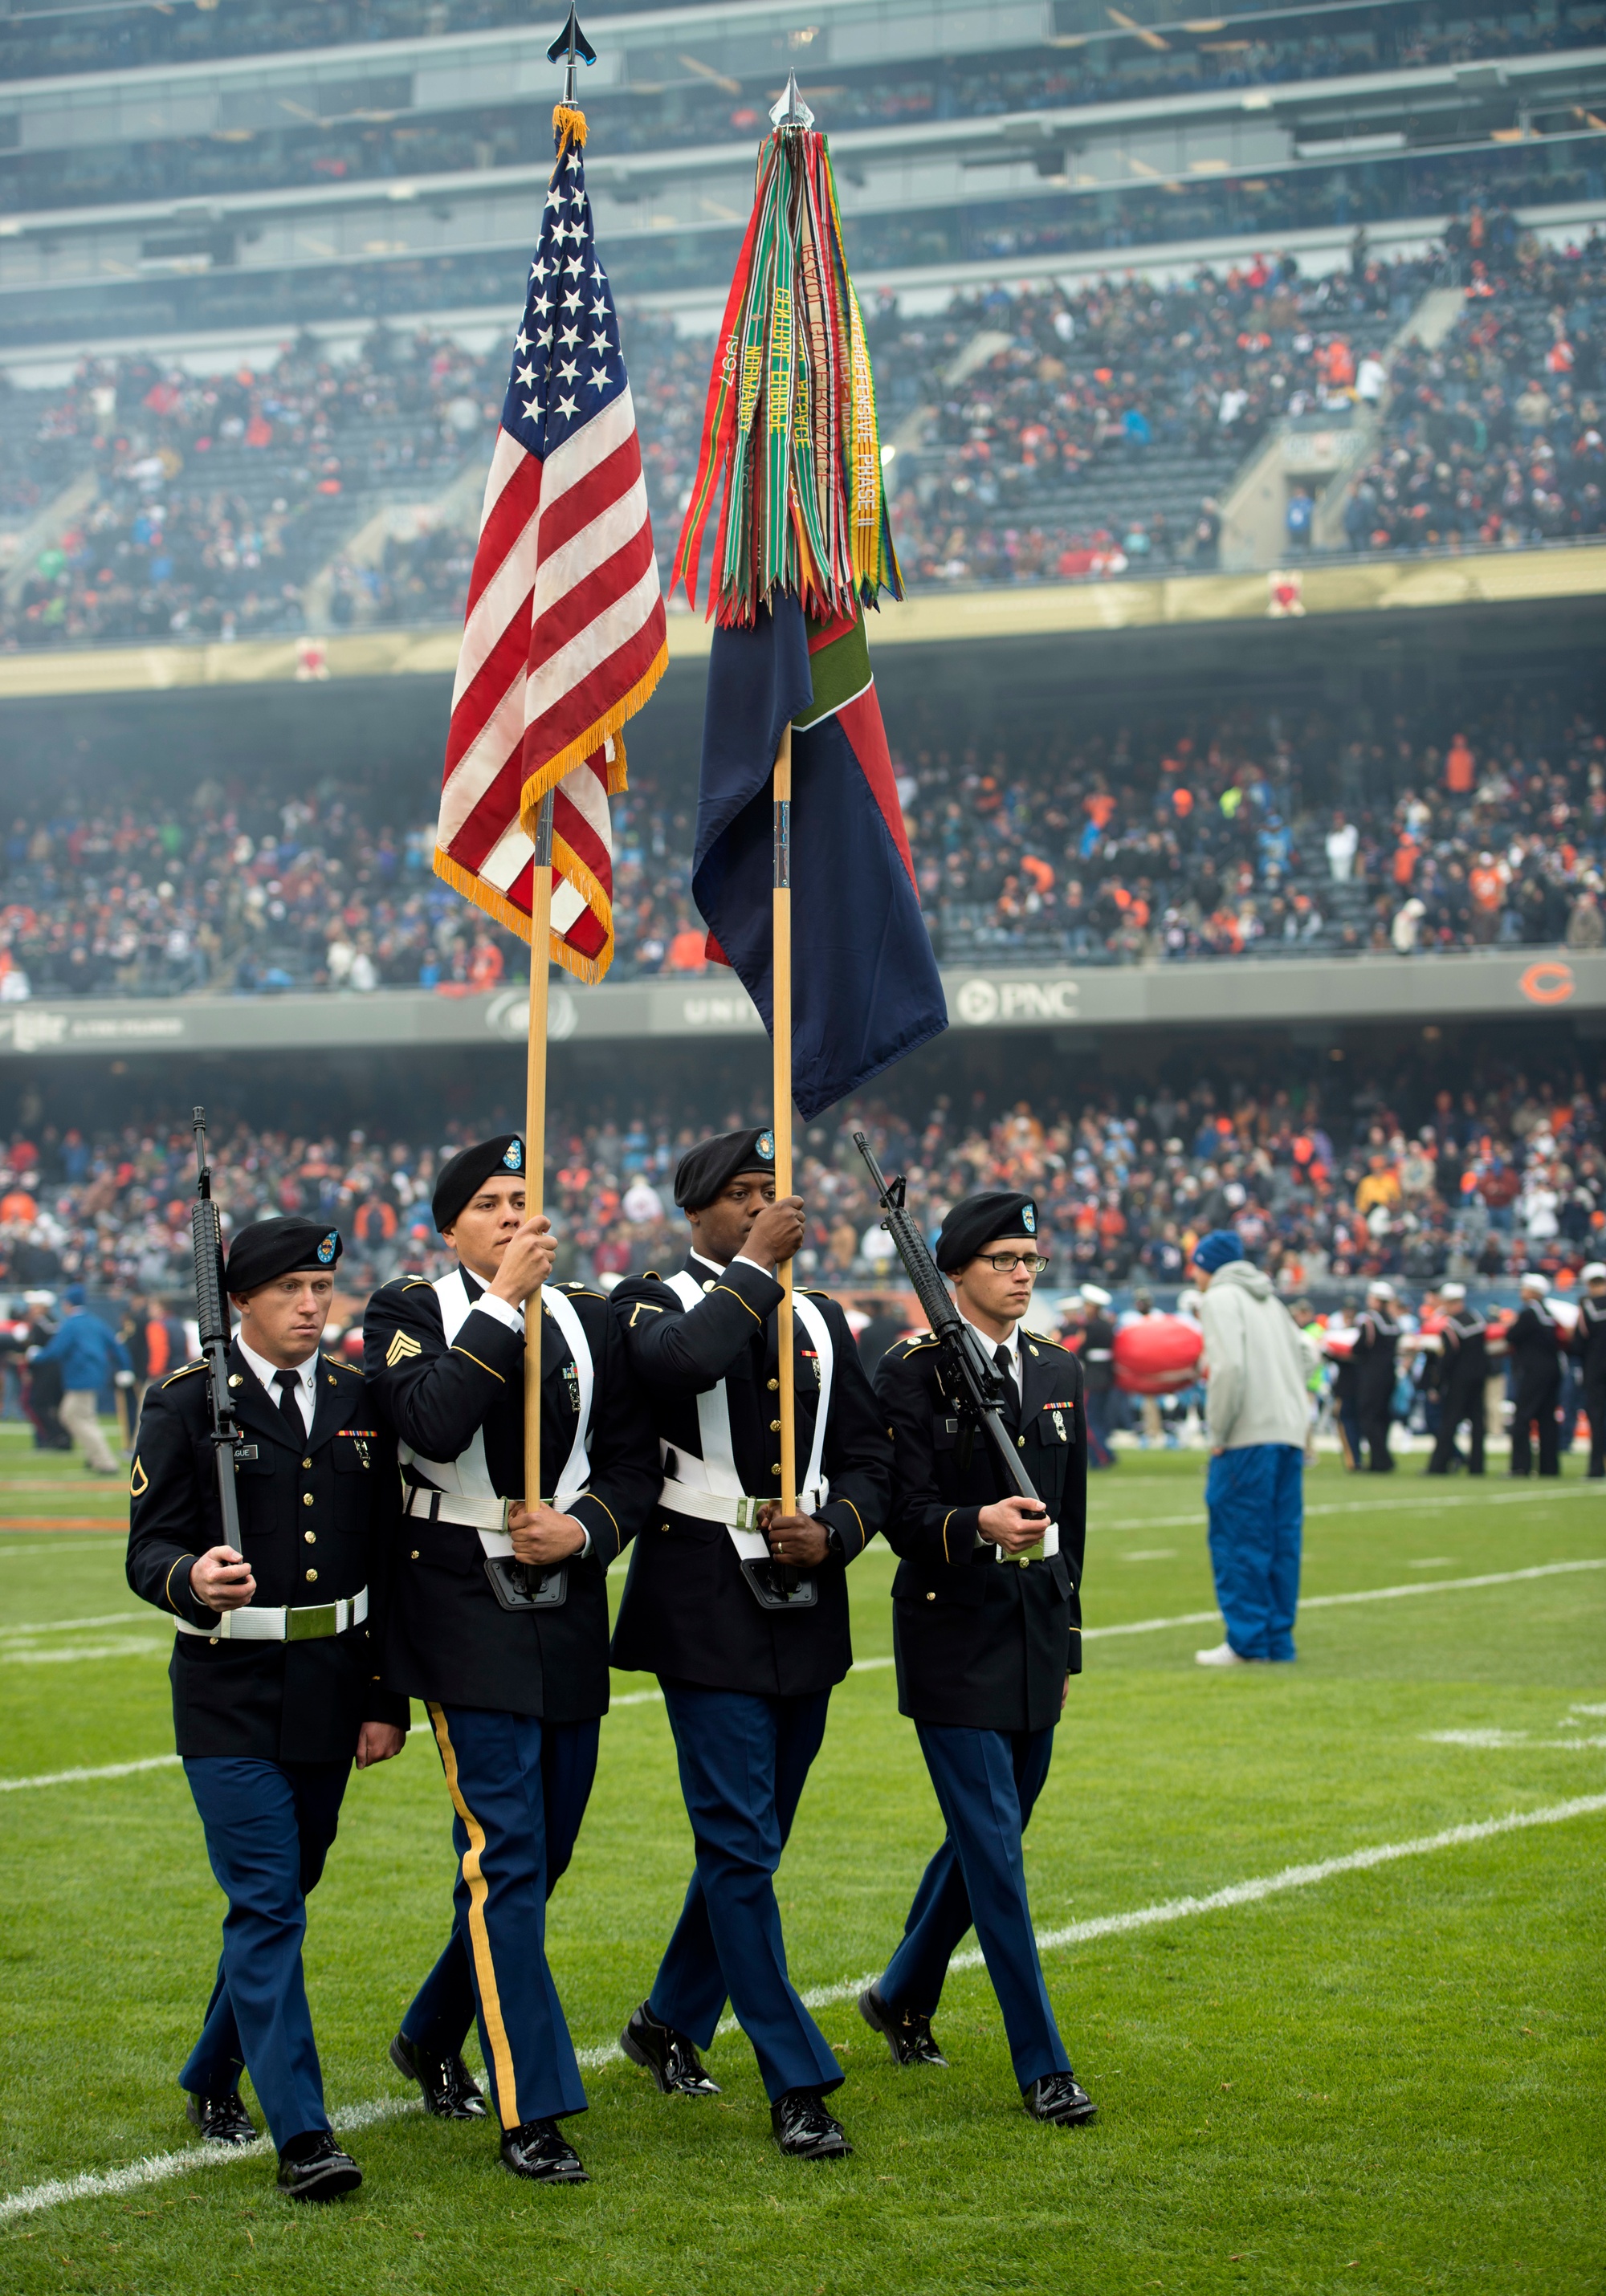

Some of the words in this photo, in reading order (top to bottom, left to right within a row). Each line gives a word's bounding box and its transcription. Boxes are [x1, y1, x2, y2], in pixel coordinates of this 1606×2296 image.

[719, 334, 740, 388] 1997
[740, 346, 761, 432] NORMANDY
[858, 454, 875, 511] PHASE
[857, 518, 875, 527] II
[1001, 981, 1078, 1019] PNC
